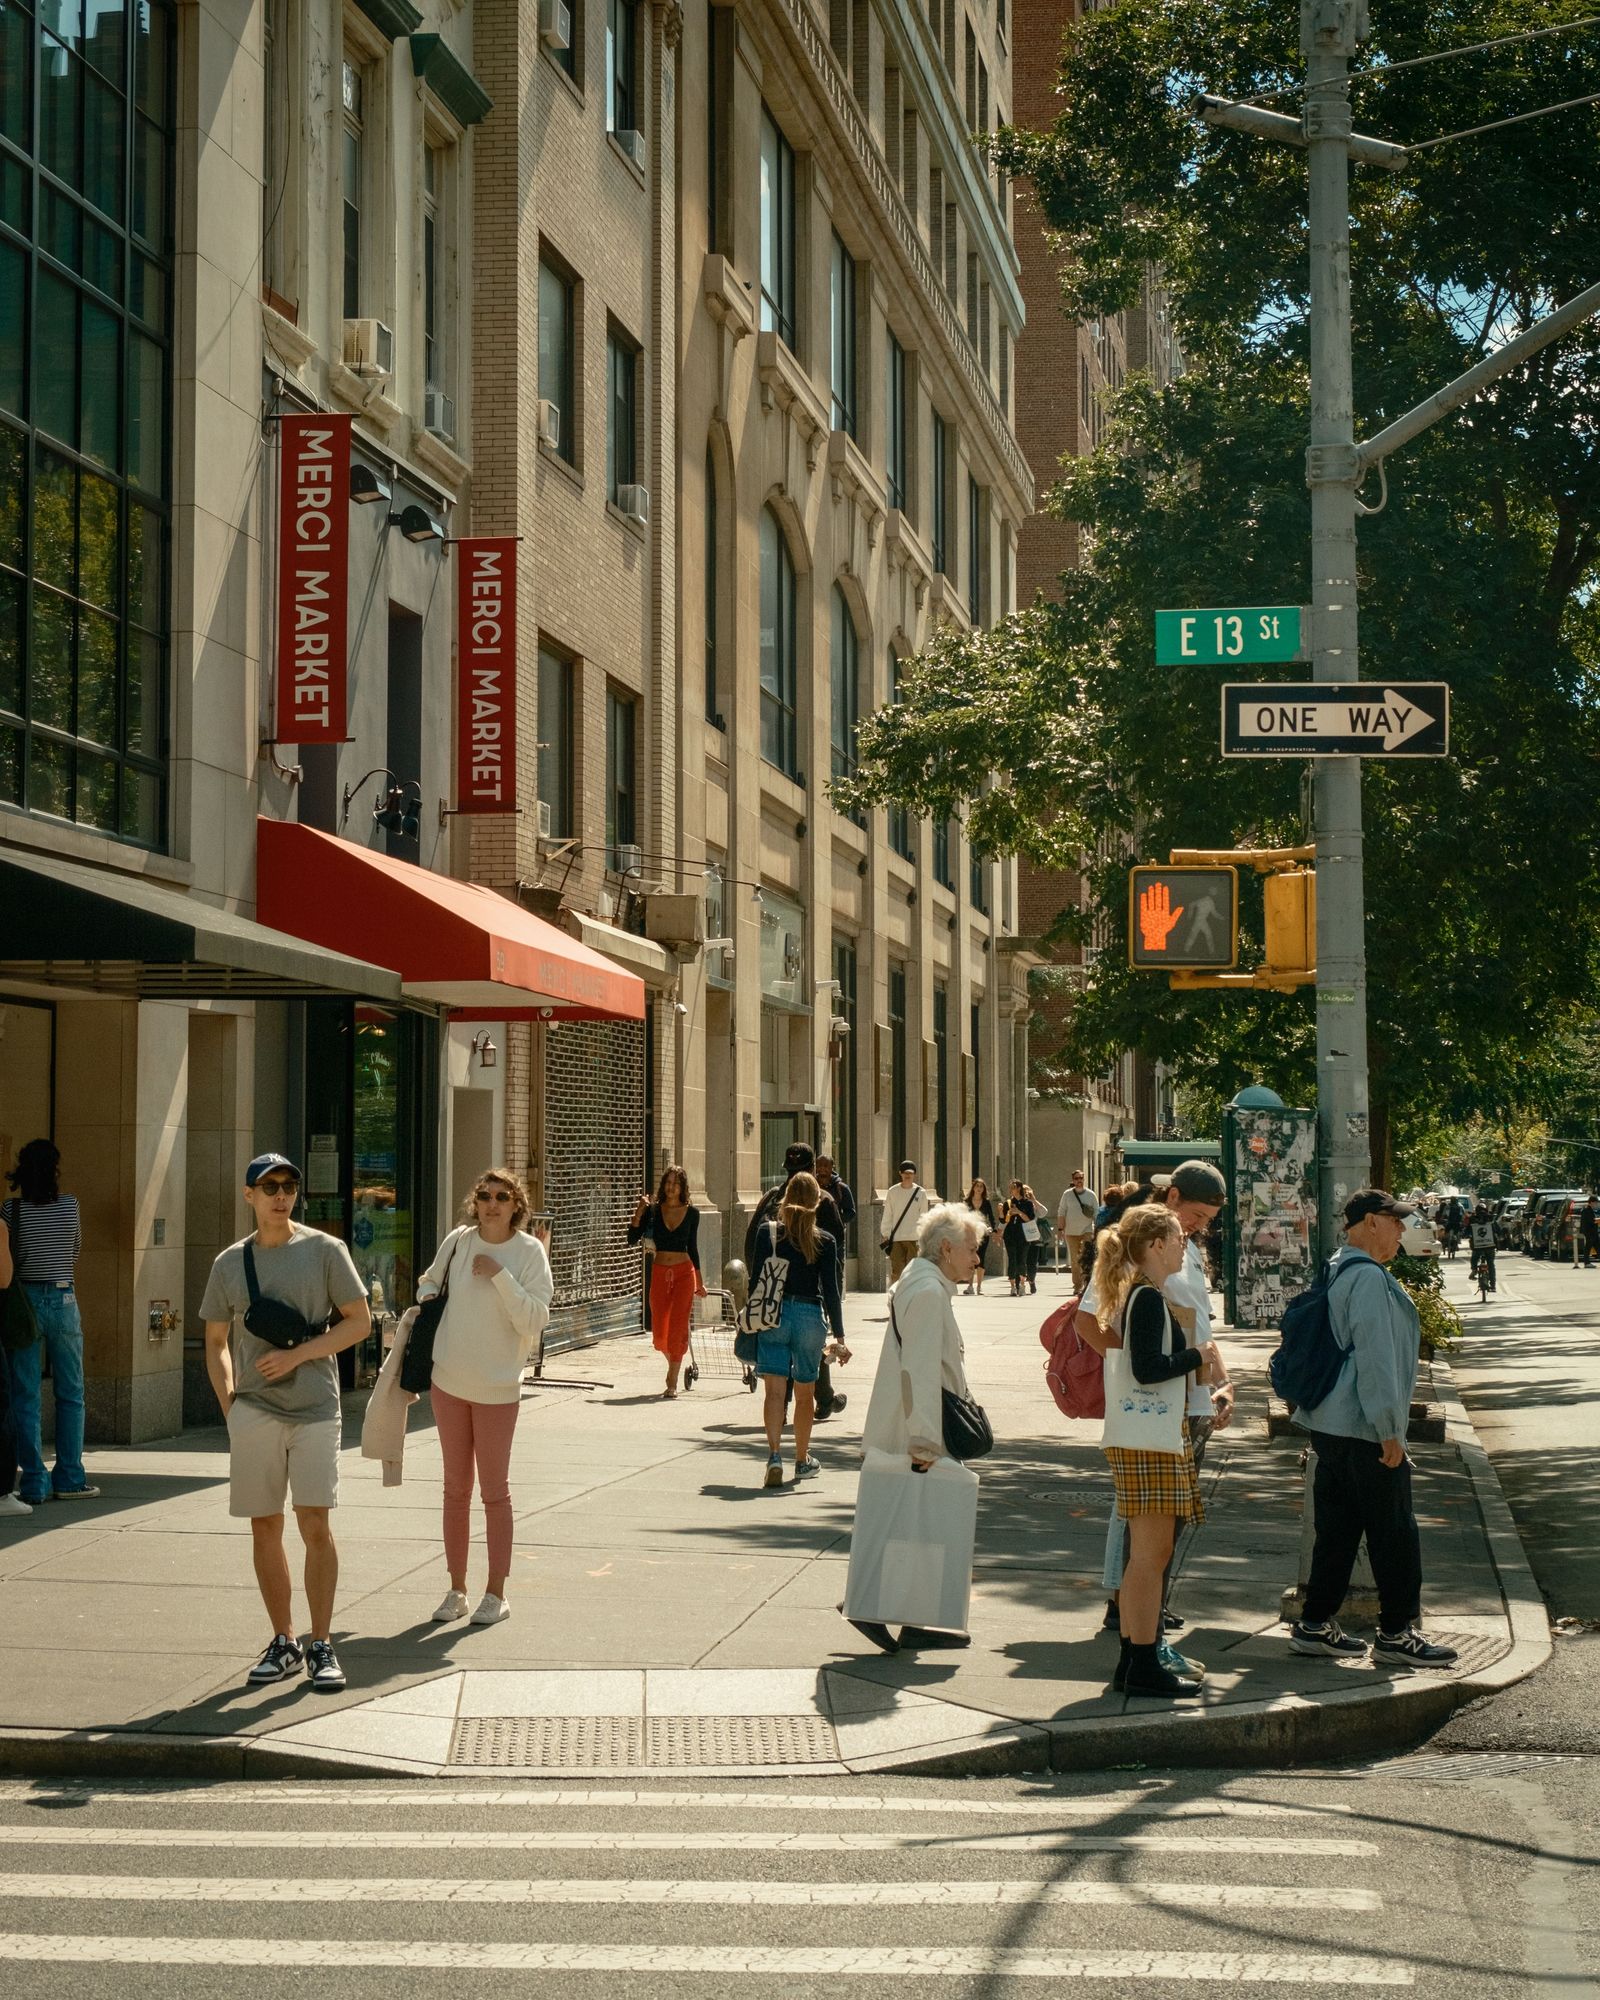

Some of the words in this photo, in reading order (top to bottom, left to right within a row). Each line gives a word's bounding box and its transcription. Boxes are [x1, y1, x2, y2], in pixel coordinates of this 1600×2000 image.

[295, 429, 334, 552] MERCI
[294, 569, 331, 728] MARKET
[471, 551, 502, 655] MERCI
[1180, 617, 1197, 656] E
[1213, 615, 1244, 656] 13
[1259, 615, 1280, 640] St
[471, 669, 502, 801] MARKET
[1256, 706, 1318, 733] ONE
[1348, 706, 1413, 733] WAY
